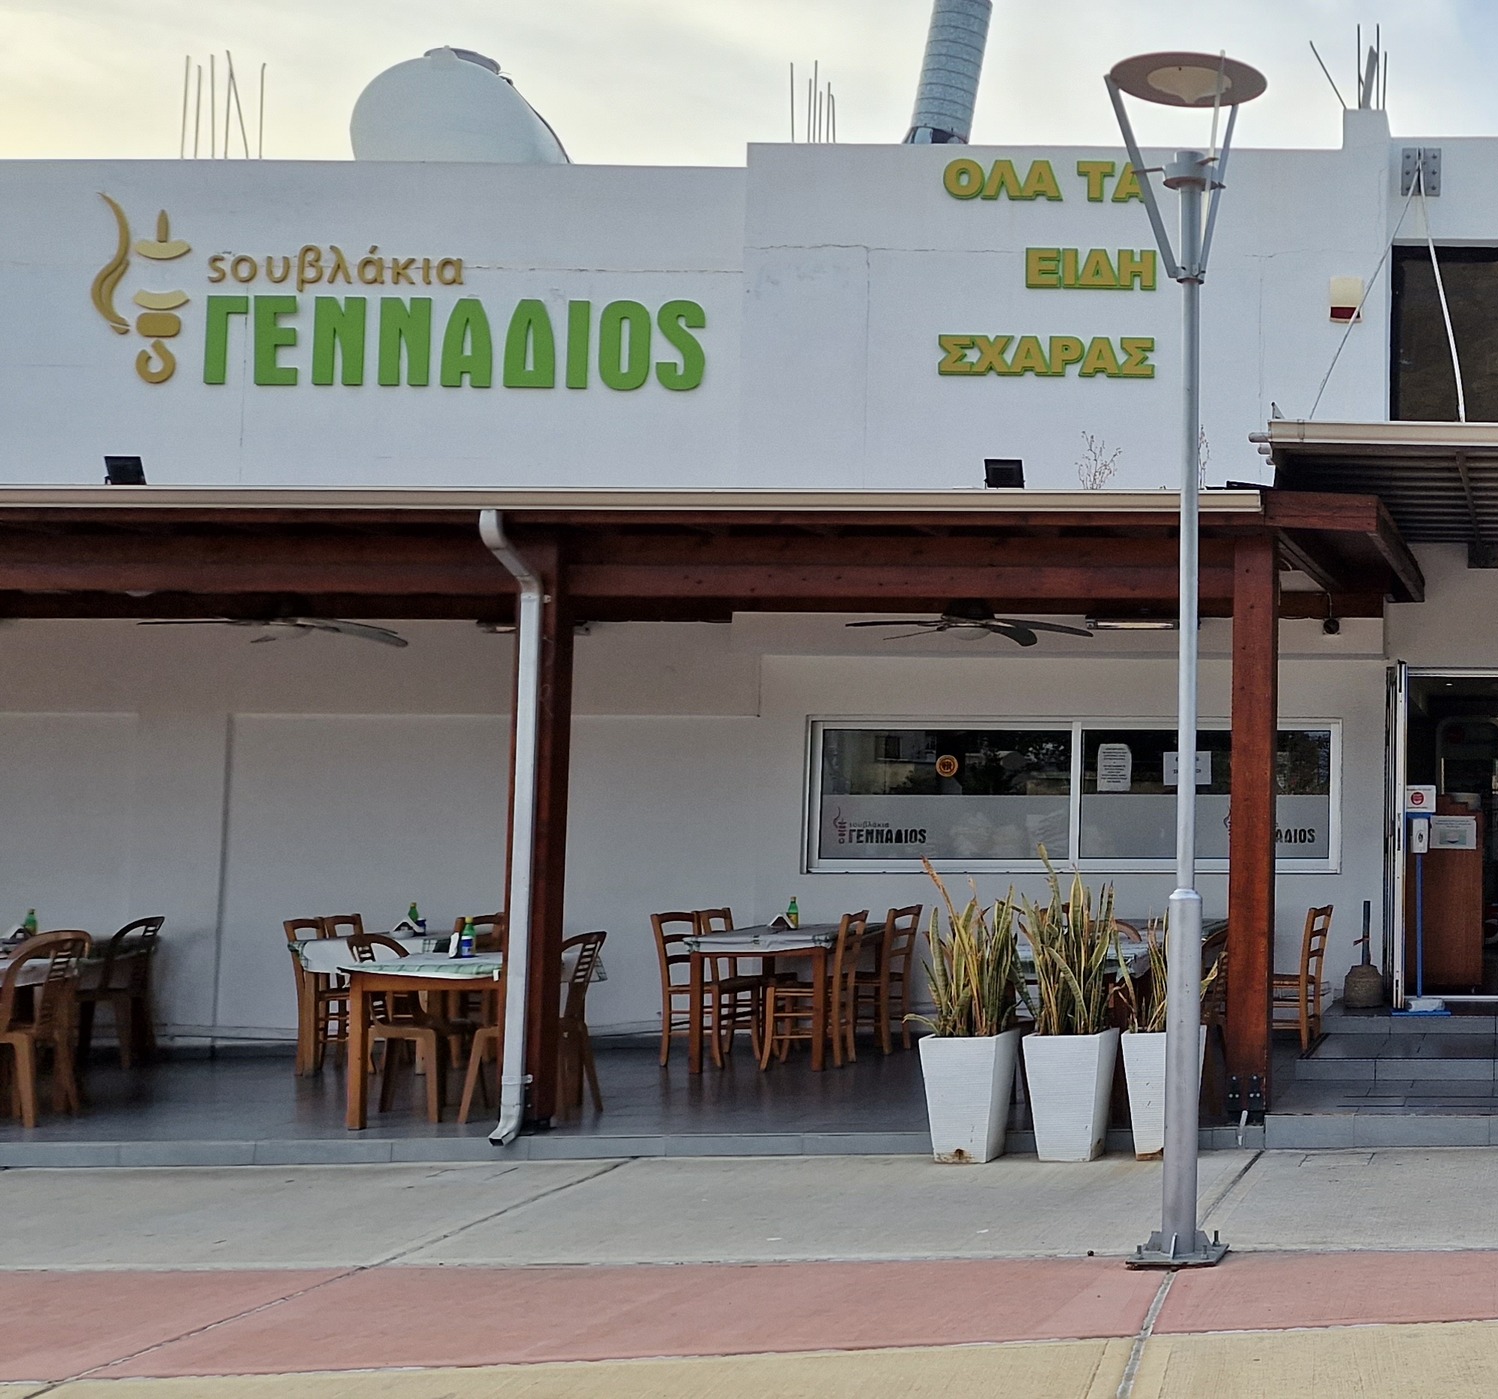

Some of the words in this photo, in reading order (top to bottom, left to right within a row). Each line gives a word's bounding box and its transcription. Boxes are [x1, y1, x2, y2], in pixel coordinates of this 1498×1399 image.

[943, 158, 1063, 201] ΟΛΑ
[1077, 160, 1146, 202] ΤΑ
[1025, 247, 1157, 291] ΕΙΔΗ
[938, 334, 1155, 378] ΣΧΑΡΑΣ
